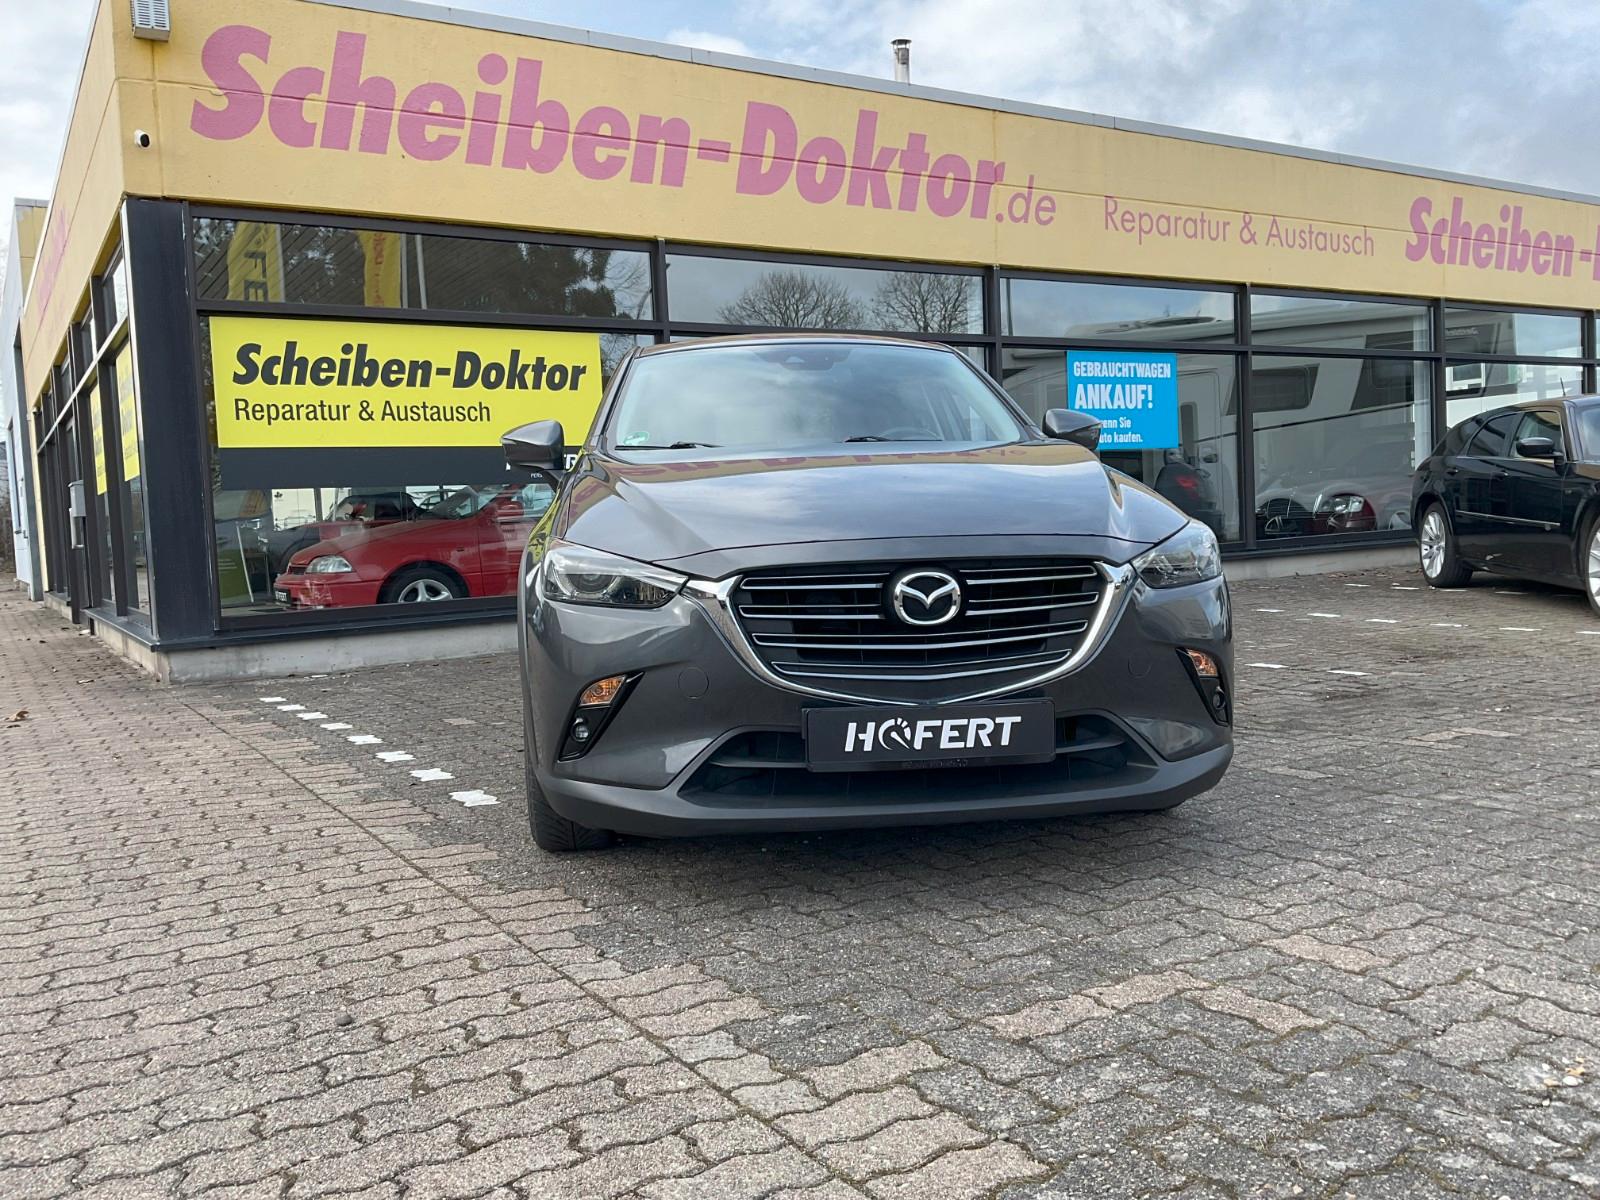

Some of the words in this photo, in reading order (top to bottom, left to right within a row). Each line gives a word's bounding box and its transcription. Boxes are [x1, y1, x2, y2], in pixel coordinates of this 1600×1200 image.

[1104, 196, 1231, 244] Reparatur
[1240, 212, 1258, 246] &
[1266, 216, 1375, 257] Austausch
[1406, 196, 1600, 281] Scheiben-
[232, 340, 587, 391] Scheiben-Doktor
[1073, 361, 1171, 378] GEBRAUCHTWAGEN
[1075, 383, 1153, 409] ANKAUF!
[234, 398, 351, 426] Reparatur
[358, 400, 375, 422] &
[381, 400, 491, 422] Austausch
[1101, 418, 1118, 429] enn
[1119, 416, 1132, 428] Sie
[1099, 432, 1112, 443] uto
[1113, 431, 1143, 444] kaufen.
